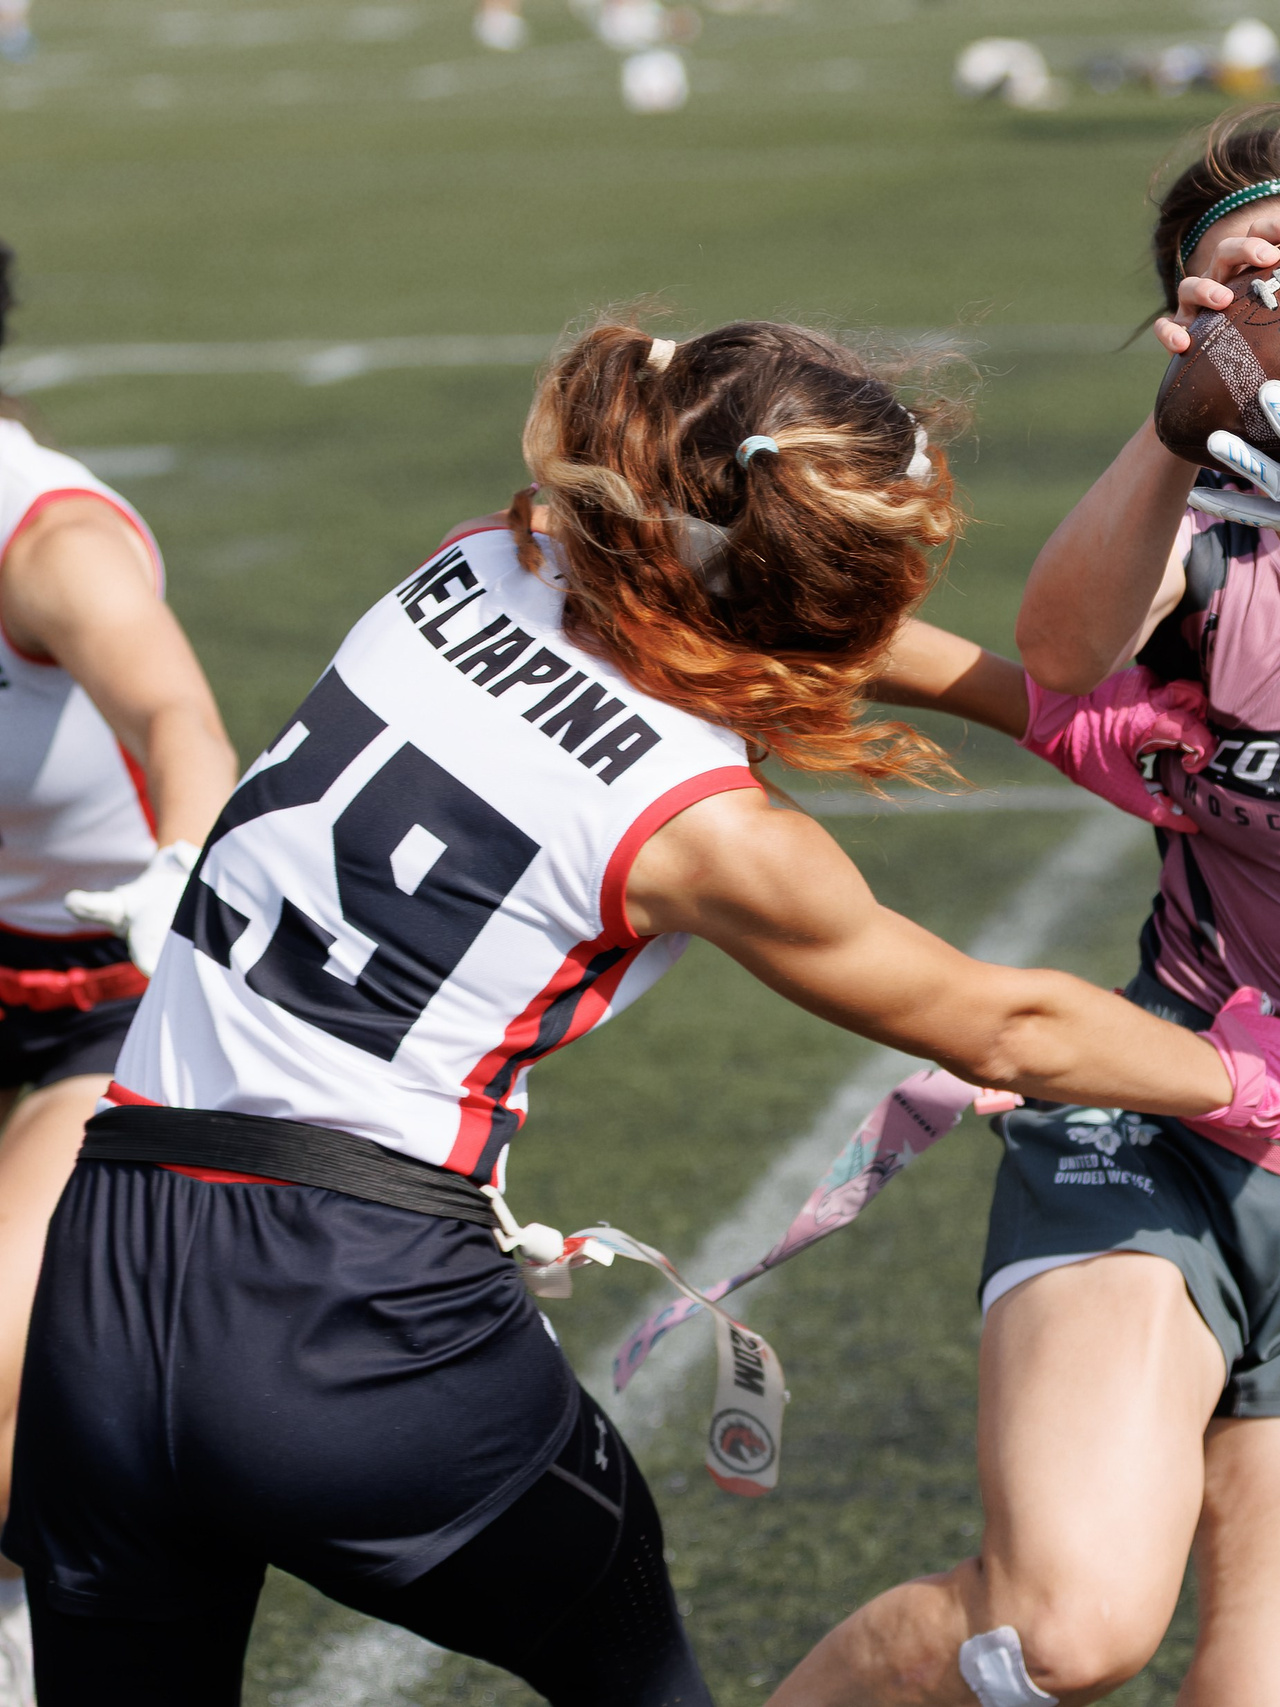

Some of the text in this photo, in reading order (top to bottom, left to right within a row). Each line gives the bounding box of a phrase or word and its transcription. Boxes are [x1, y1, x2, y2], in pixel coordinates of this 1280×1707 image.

[171, 663, 542, 1062] 29
[1057, 1153, 1099, 1171] UNITED
[1053, 1170, 1107, 1185] DIVIDED
